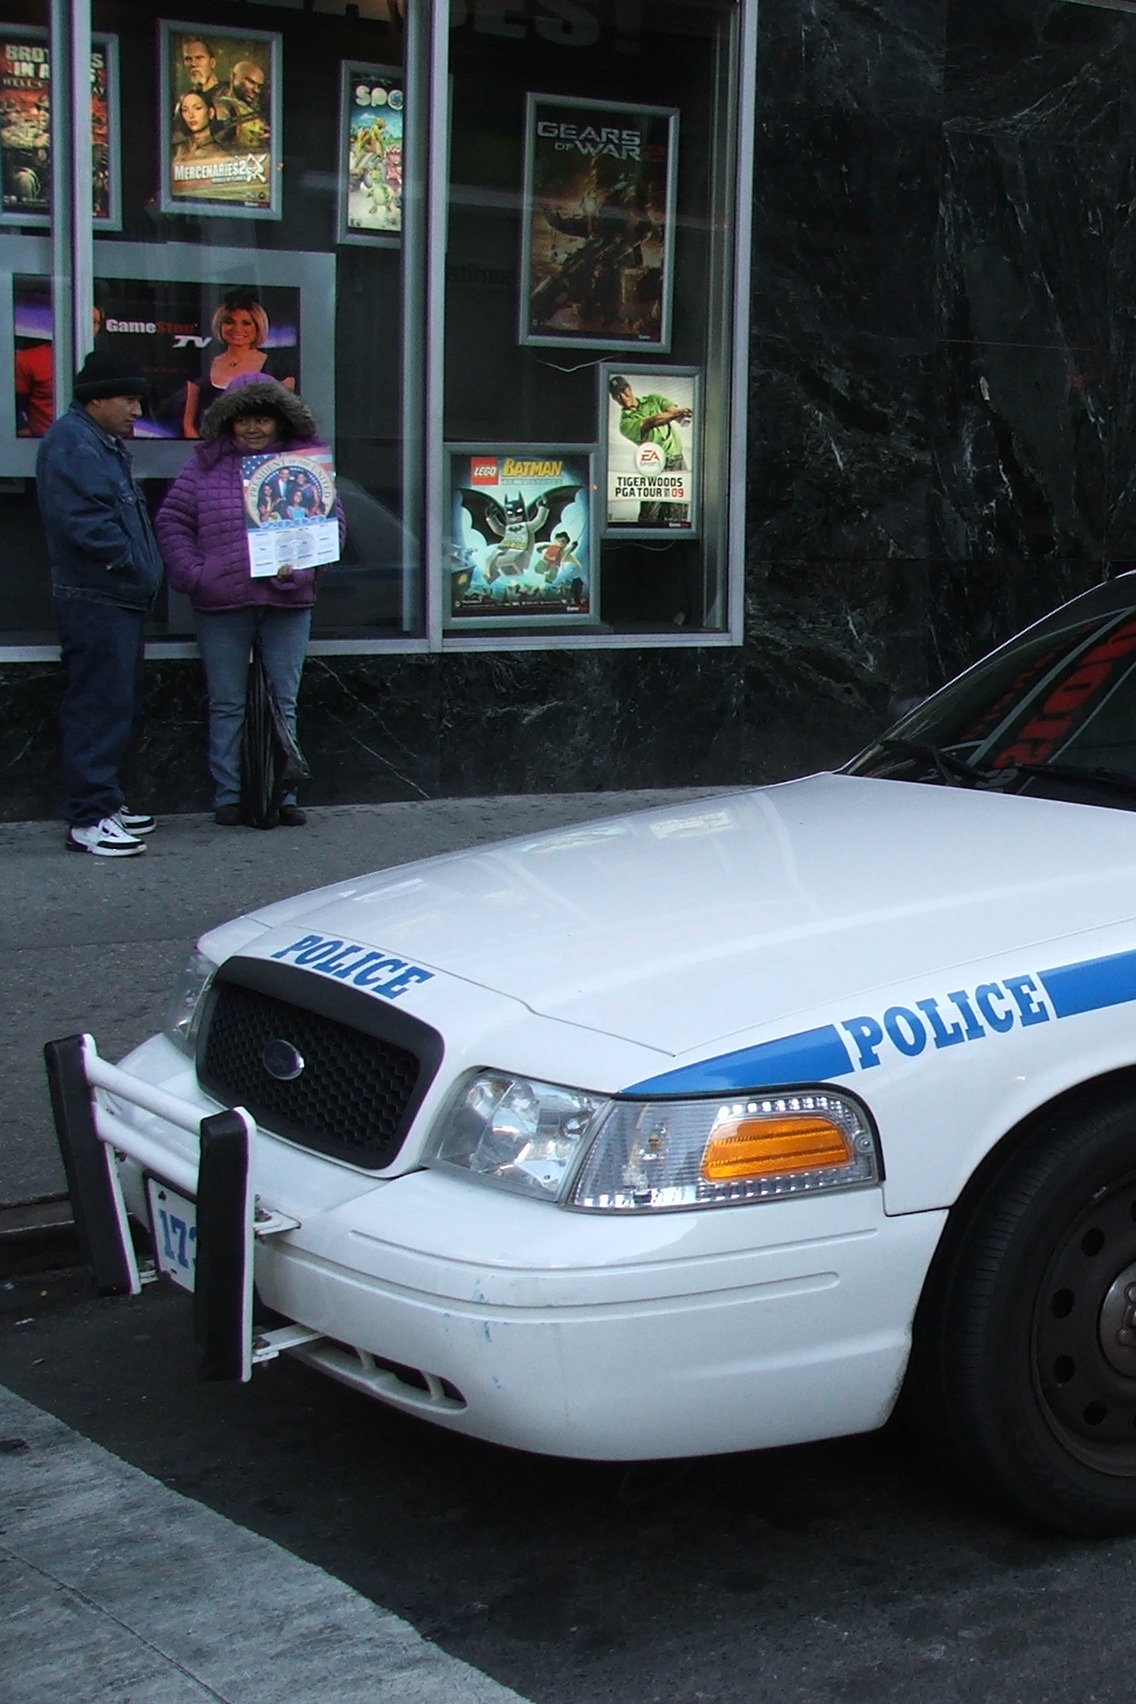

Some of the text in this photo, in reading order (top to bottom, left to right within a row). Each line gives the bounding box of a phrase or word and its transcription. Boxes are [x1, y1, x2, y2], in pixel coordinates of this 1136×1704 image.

[4, 44, 104, 69] BROS
[14, 61, 35, 77] IN
[355, 85, 403, 111] SPO
[537, 121, 641, 145] GEARS
[554, 142, 575, 152] OF
[575, 140, 642, 162] WAR
[171, 334, 213, 349] TV
[641, 449, 660, 461] EA
[474, 457, 563, 477] LEGO BATMAN
[615, 487, 684, 497] PGA TOUR 09
[617, 476, 683, 487] TIGER WOODS
[270, 934, 436, 1000] POLICE
[841, 974, 1050, 1070] POLICE
[159, 1209, 198, 1269] 17
